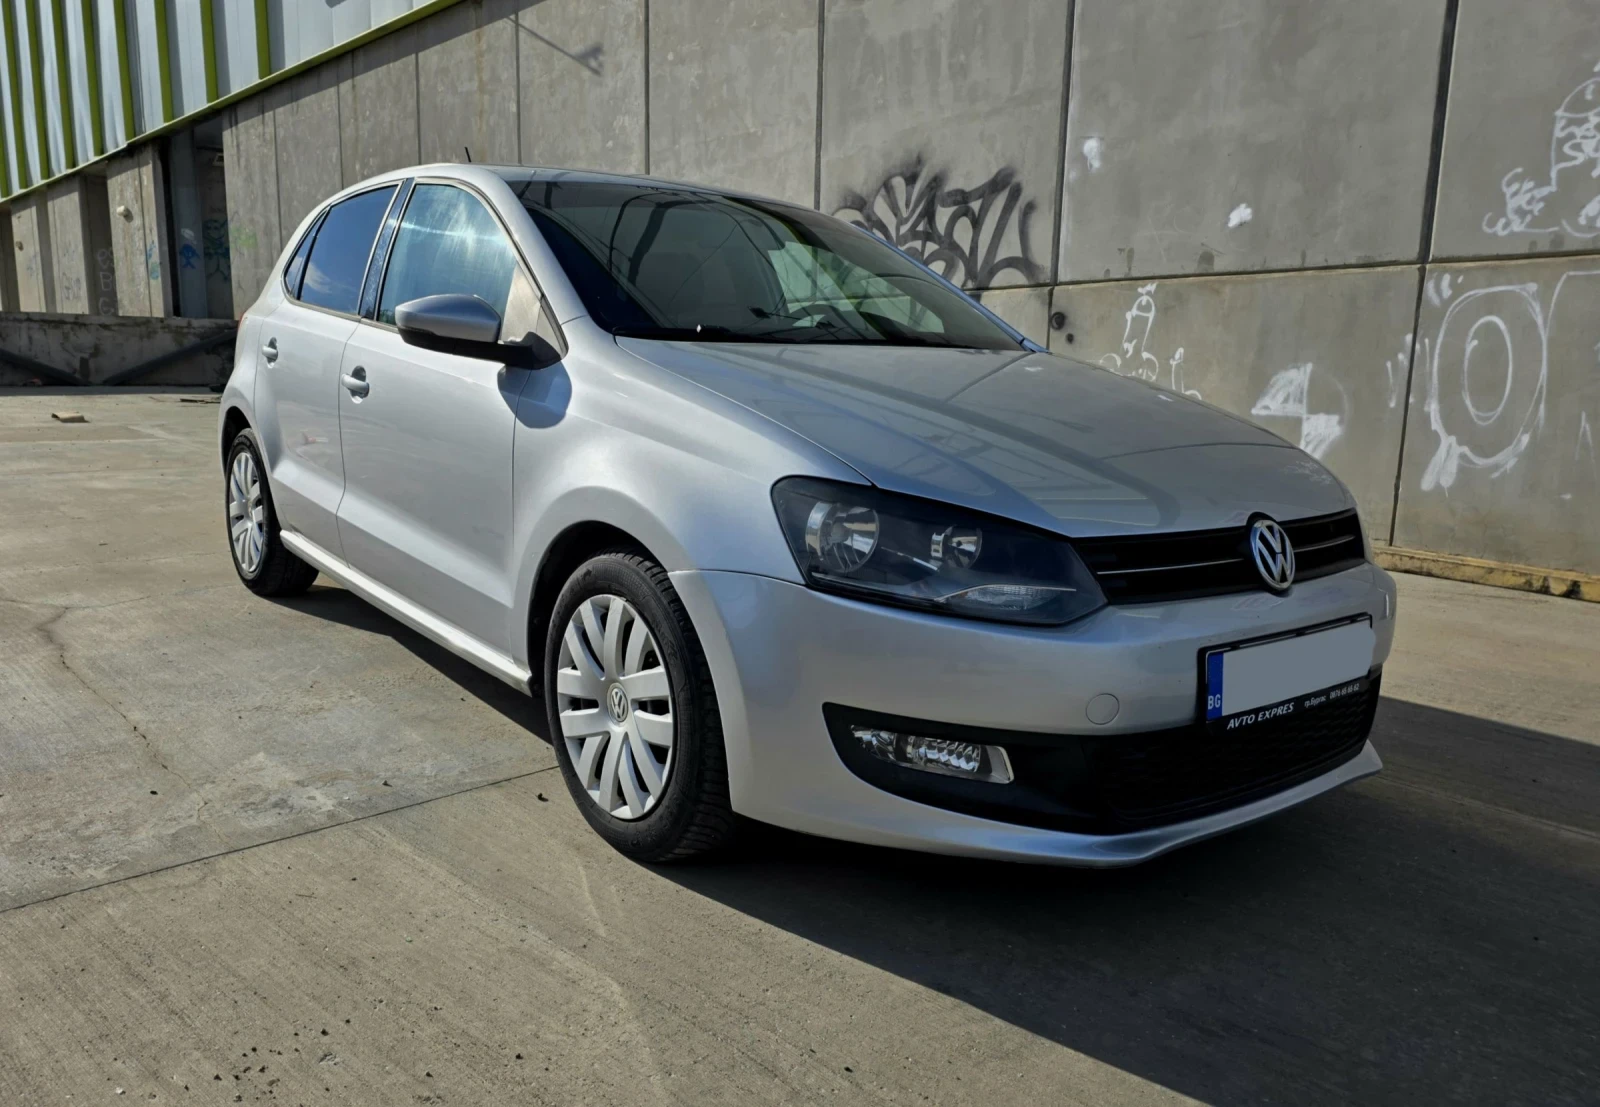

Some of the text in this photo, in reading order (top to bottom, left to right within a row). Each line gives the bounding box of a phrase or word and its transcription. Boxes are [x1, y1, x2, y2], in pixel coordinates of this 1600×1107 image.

[1207, 694, 1221, 710] BG
[1226, 702, 1295, 730] AVTO EXPRES
